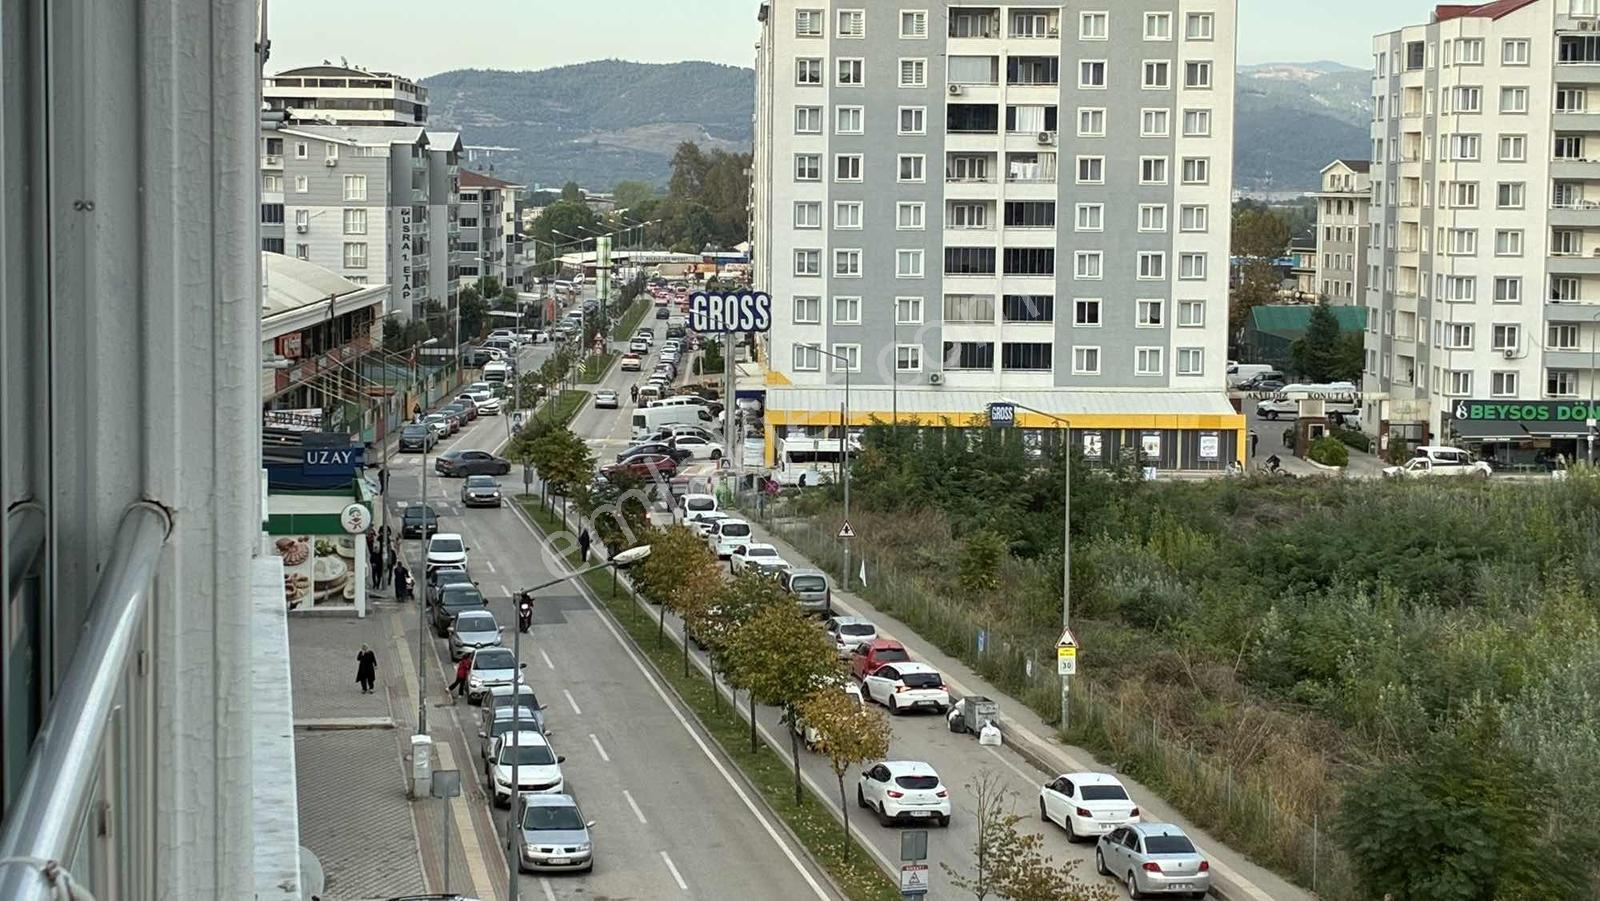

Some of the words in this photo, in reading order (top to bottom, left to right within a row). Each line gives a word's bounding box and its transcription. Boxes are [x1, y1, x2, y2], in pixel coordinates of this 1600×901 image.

[402, 266, 411, 299] ETAP
[693, 295, 769, 331] GROSS
[992, 406, 1014, 420] GROSS
[1470, 404, 1549, 420] BEYSOS
[307, 451, 352, 464] UZAY
[1062, 661, 1072, 669] 30
